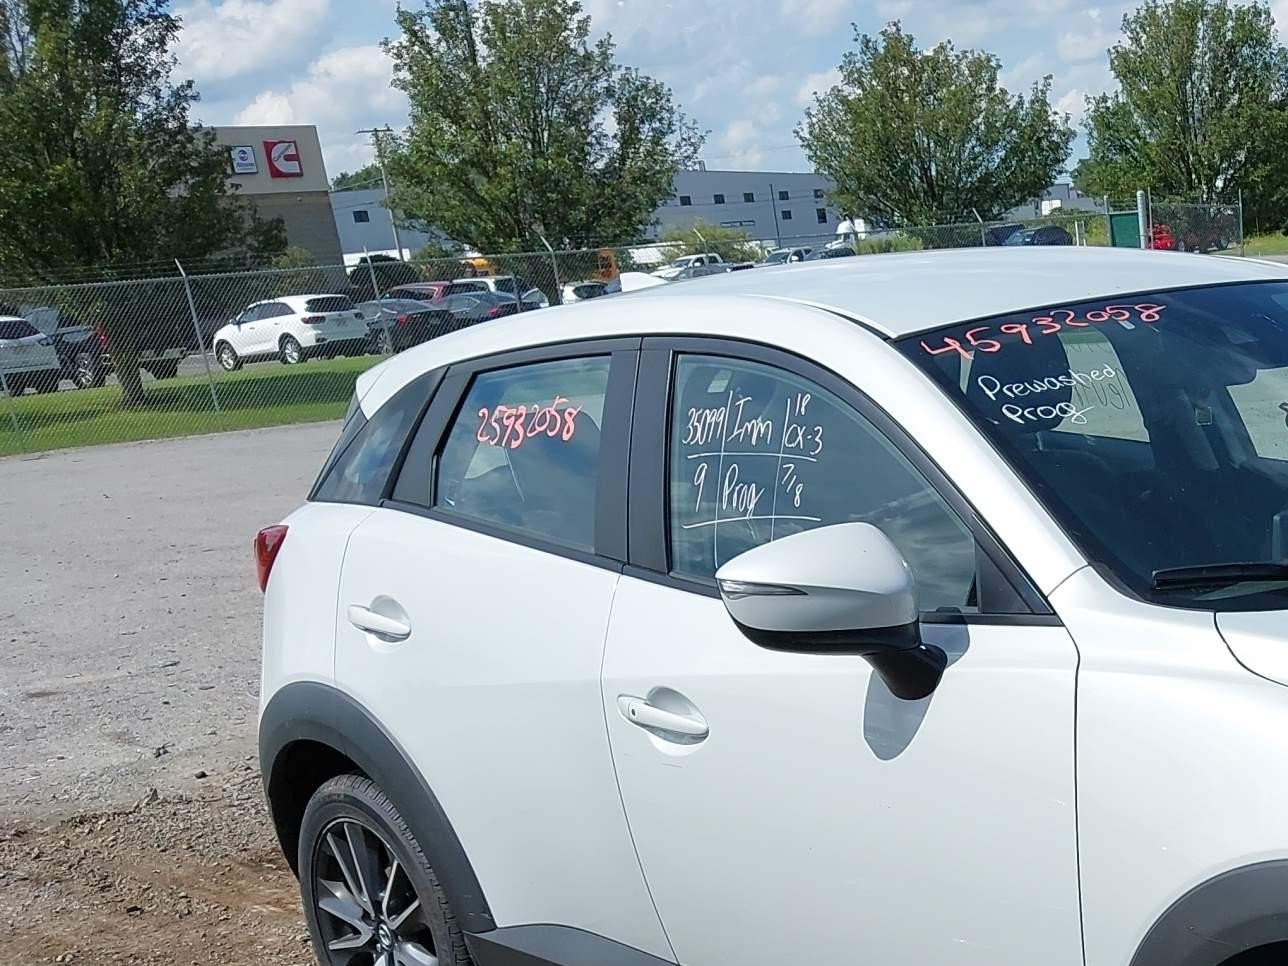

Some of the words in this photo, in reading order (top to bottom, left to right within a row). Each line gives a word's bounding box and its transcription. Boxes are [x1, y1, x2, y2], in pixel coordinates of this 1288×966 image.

[920, 303, 1167, 360] 45932058
[977, 363, 1116, 400] Prewashed
[794, 393, 811, 416] 18
[1001, 401, 1094, 424] Prog
[682, 407, 726, 445] 35099
[784, 424, 823, 455] CX-3
[694, 462, 708, 513] 9
[722, 463, 765, 519] Prog
